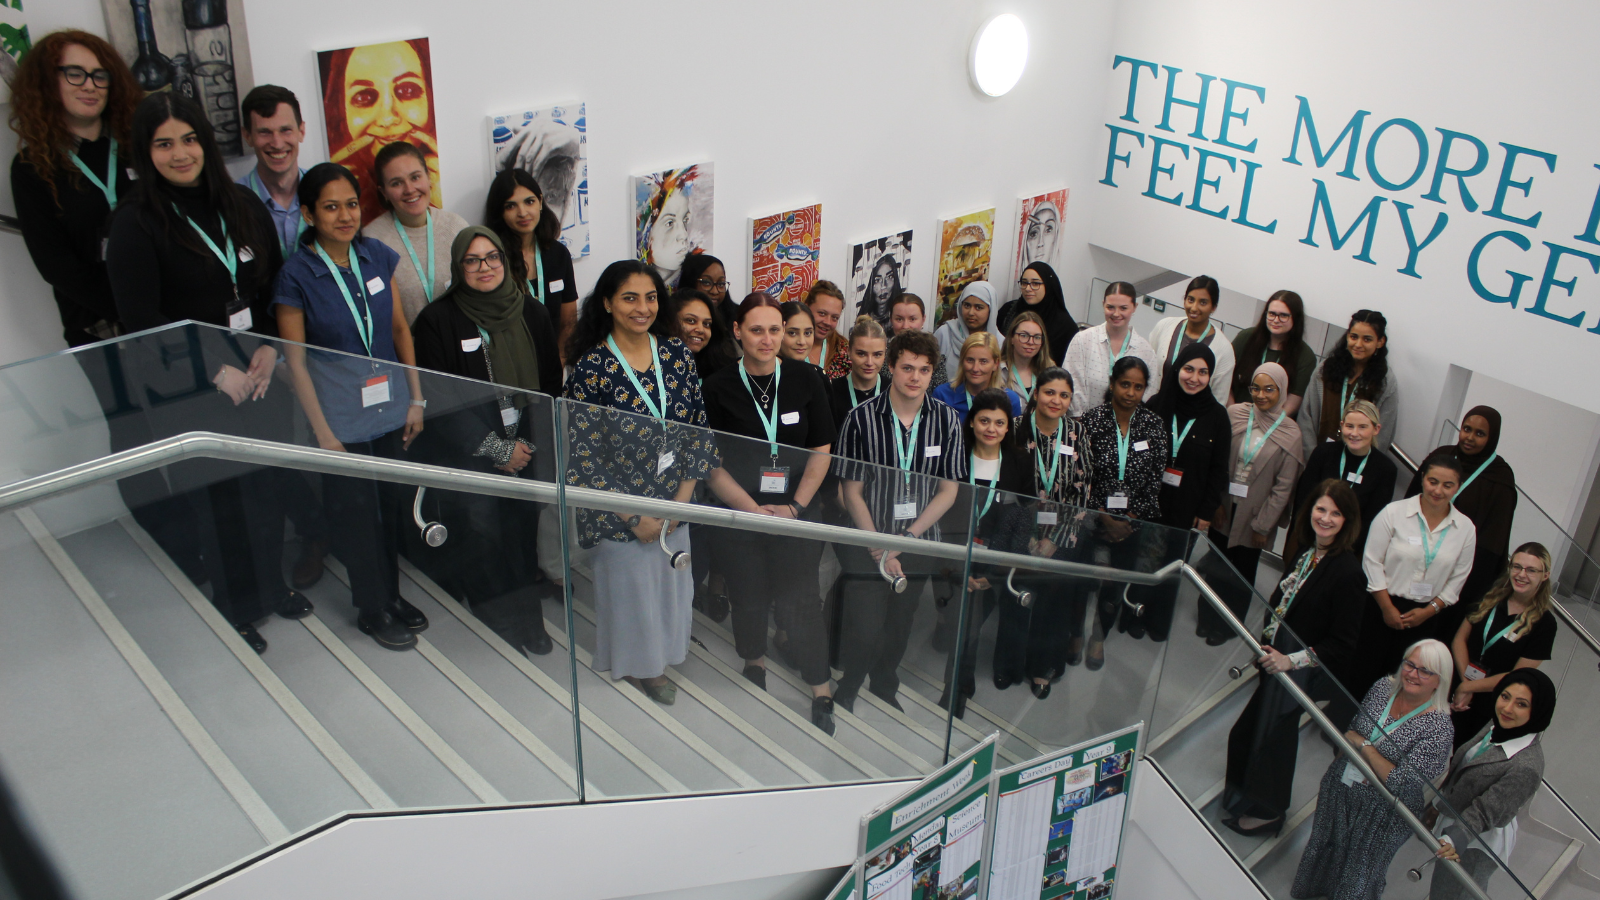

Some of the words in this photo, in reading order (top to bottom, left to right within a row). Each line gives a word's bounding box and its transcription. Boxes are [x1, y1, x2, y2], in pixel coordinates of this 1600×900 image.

[1112, 54, 1266, 153] THE
[1281, 95, 1558, 229] MORE
[1098, 123, 1278, 234] FEEL
[1298, 178, 1449, 280] MY
[1466, 230, 1600, 336] GE
[1086, 750, 1104, 760] Year
[1106, 745, 1111, 754] 9
[1020, 763, 1052, 780] Careers
[1054, 758, 1071, 770] Day
[895, 788, 949, 825] Enrichment
[952, 769, 971, 791] Week
[952, 799, 981, 824] Science
[914, 819, 944, 844] Monday
[948, 812, 983, 840] Museum
[915, 842, 932, 856] Year
[933, 835, 939, 844] 8
[871, 875, 892, 893] Food
[895, 861, 911, 878] Tech
